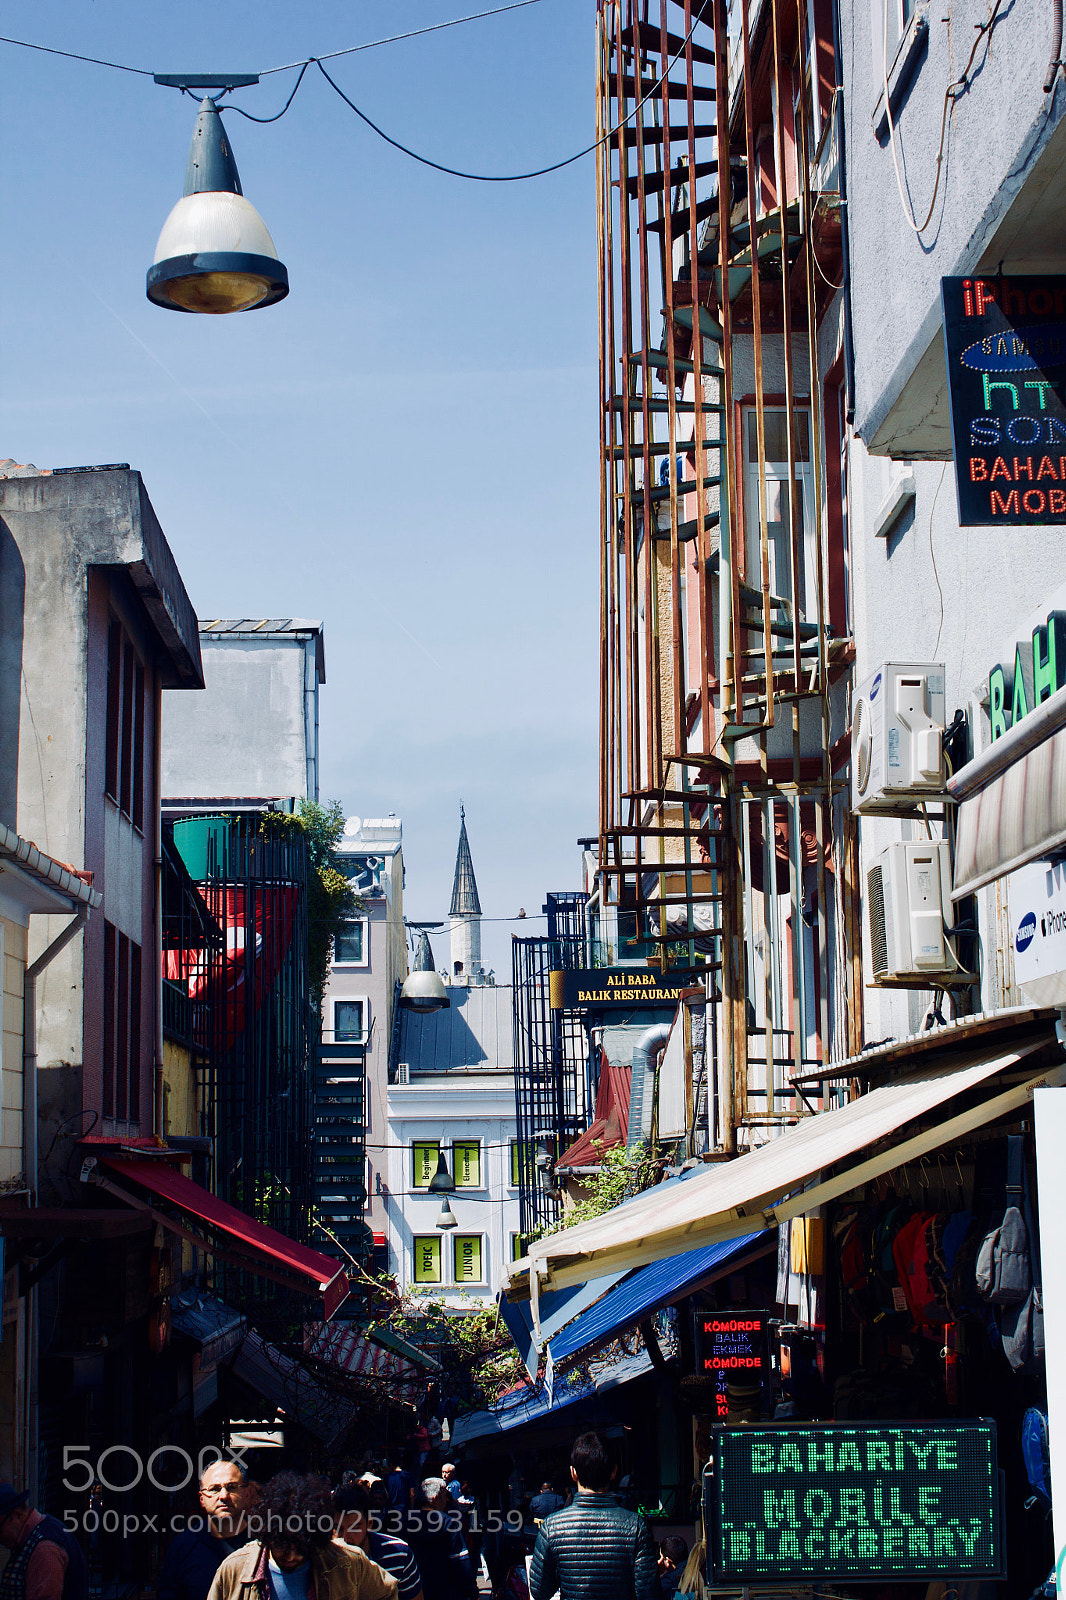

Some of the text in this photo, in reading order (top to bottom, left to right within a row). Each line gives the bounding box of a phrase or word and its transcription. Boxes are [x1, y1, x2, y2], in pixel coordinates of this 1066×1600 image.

[989, 489, 1066, 515] MOB
[1017, 922, 1035, 942] SAMSUNG
[606, 972, 657, 986] ALİ BABA
[578, 989, 612, 1002] BALIK
[422, 1148, 431, 1180] Beginner
[423, 1246, 433, 1273] TOEIC
[463, 1242, 473, 1276] JUNIOR
[704, 1320, 761, 1333] KÖMÜRDE
[715, 1333, 749, 1343] BALIK
[713, 1344, 753, 1355] EKMEK
[704, 1356, 762, 1369] KÖMÜRDE
[729, 1526, 983, 1561] BLACKBERRY
